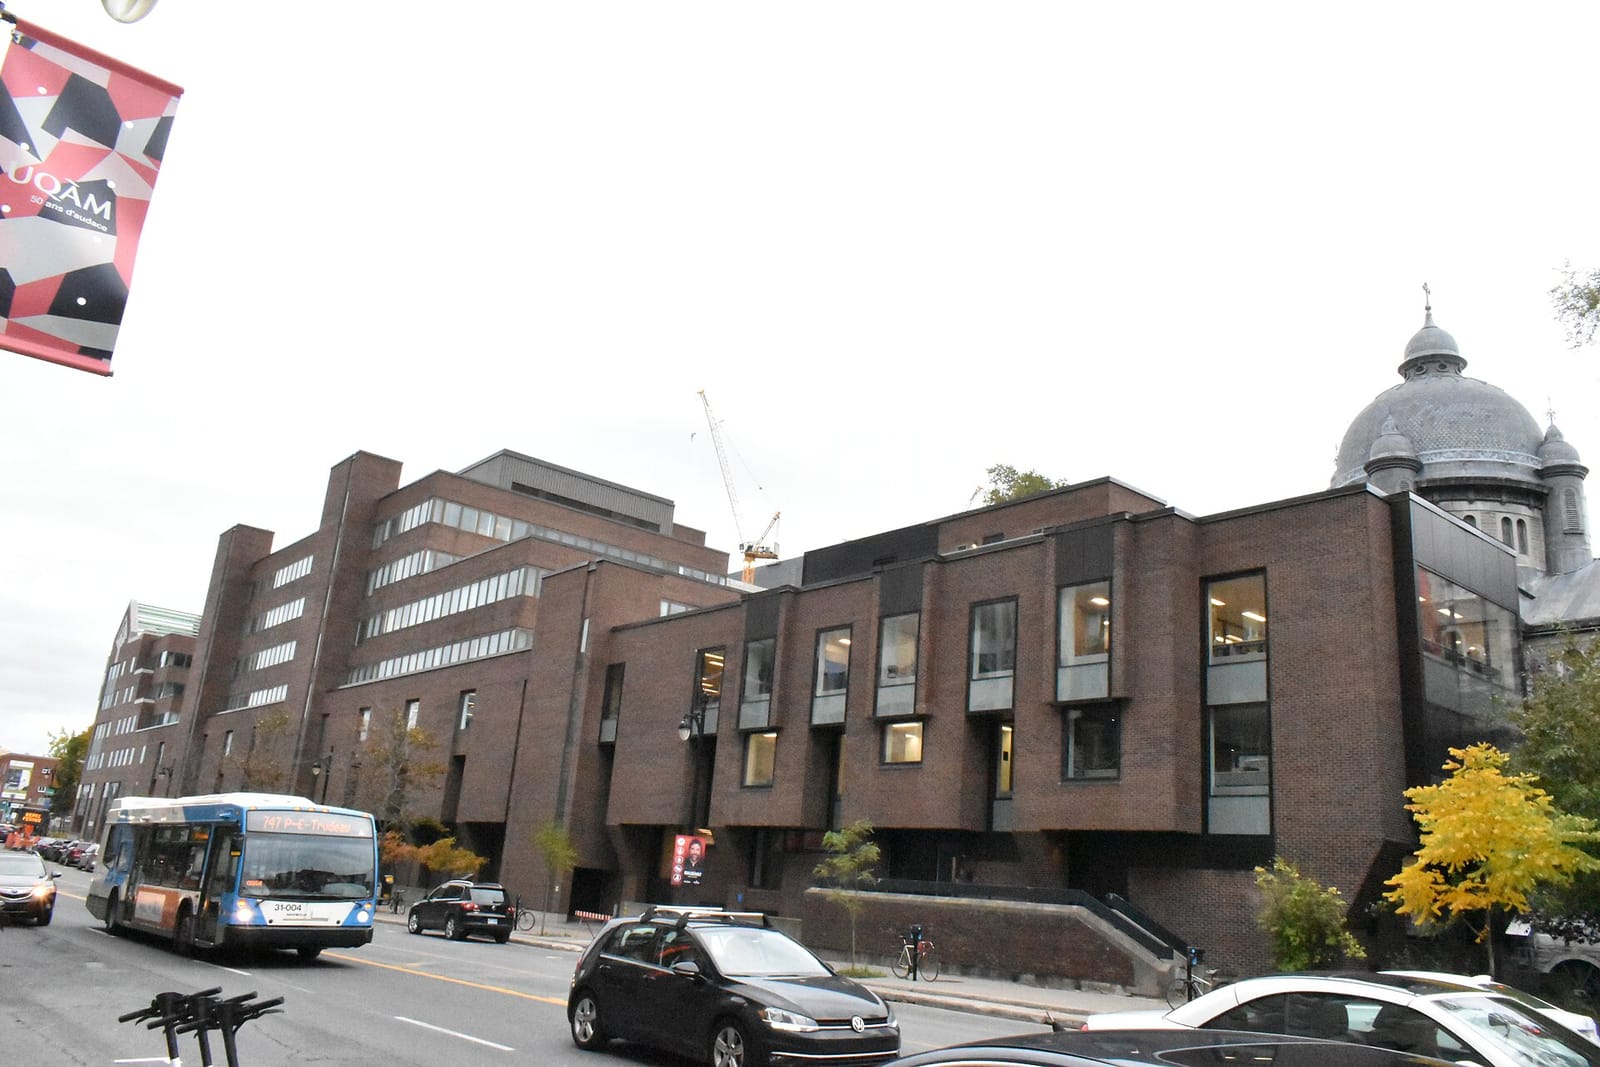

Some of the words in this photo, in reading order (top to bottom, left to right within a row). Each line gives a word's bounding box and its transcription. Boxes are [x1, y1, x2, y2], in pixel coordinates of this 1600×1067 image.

[7, 162, 112, 220] UQÀM
[30, 195, 44, 205] 50
[45, 201, 64, 213] ans
[65, 209, 108, 232] d'audace
[263, 815, 282, 830] 747
[274, 903, 302, 912] 31-004
